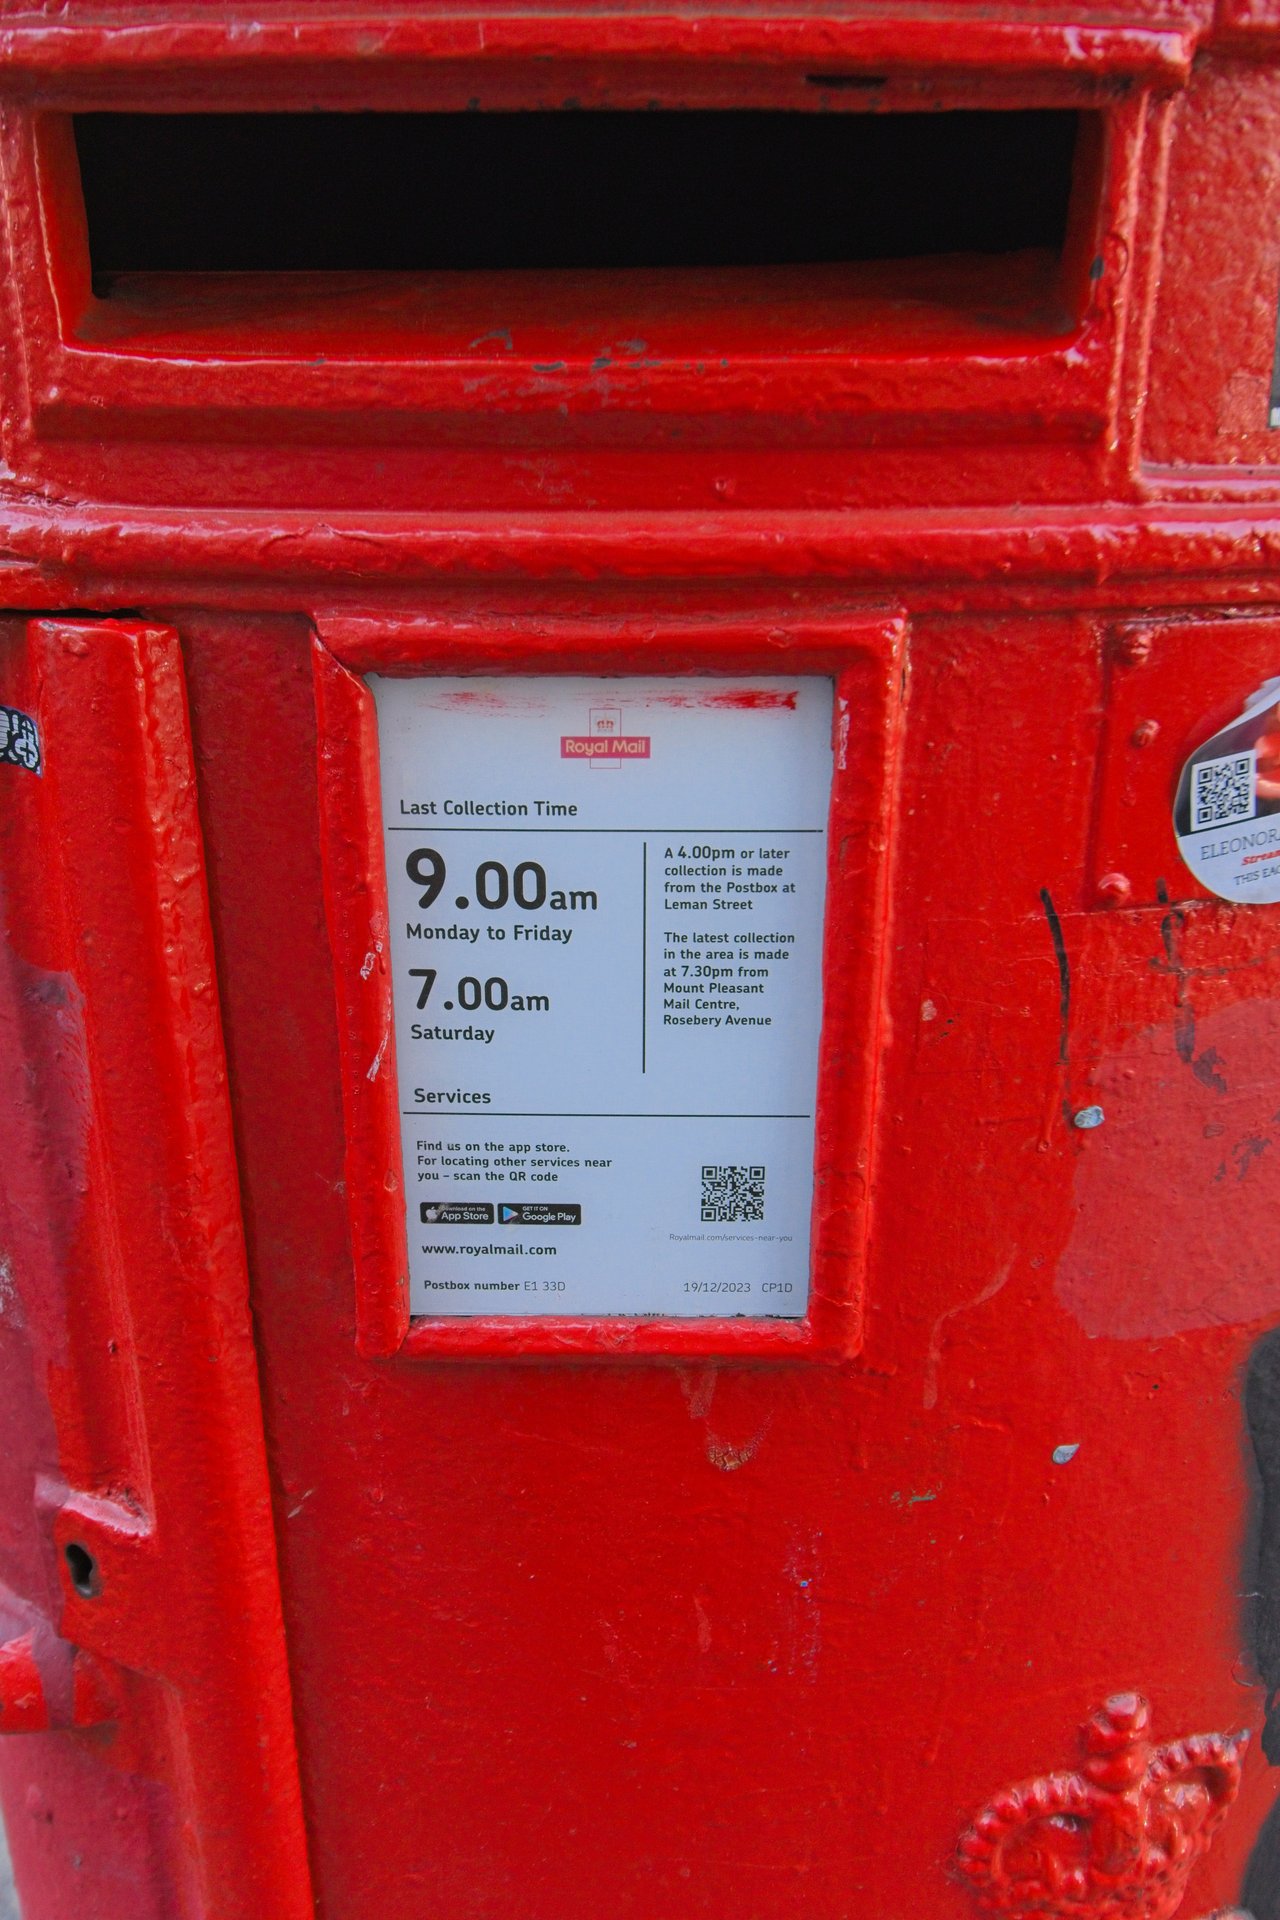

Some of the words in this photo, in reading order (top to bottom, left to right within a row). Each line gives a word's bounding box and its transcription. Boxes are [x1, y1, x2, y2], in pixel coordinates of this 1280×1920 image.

[565, 740, 608, 756] Royal
[612, 740, 646, 753] Mail
[400, 800, 438, 815] Last
[444, 800, 528, 816] Collection
[534, 801, 578, 817] Time
[1200, 828, 1280, 860] ELEONOR
[665, 848, 674, 859] A
[678, 846, 736, 862] 4.00pm
[741, 851, 755, 859] or
[760, 848, 791, 860] later
[665, 865, 727, 877] collection
[732, 865, 743, 877] is
[747, 865, 784, 877] made
[406, 848, 597, 910] 9.00am
[1234, 870, 1260, 886] THIS
[664, 882, 696, 893] from
[701, 882, 722, 894] the
[727, 882, 778, 894] Postbox
[783, 883, 796, 894] at
[665, 899, 708, 910] Leman
[713, 899, 753, 910] Street
[406, 923, 480, 944] Monday
[487, 926, 506, 941] to
[514, 925, 573, 945] Friday
[664, 932, 689, 944] The
[693, 932, 730, 944] latest
[734, 932, 796, 944] collection
[664, 948, 676, 960] in
[680, 949, 702, 960] the
[706, 952, 734, 960] area
[739, 949, 750, 960] is
[754, 949, 790, 960] made
[664, 968, 677, 978] at
[681, 966, 734, 980] 7.30pm
[738, 967, 769, 978] from
[408, 969, 549, 1011] 7.00am
[664, 983, 705, 994] Mount
[710, 983, 765, 994] Pleasant
[664, 999, 690, 1010] Mail
[695, 999, 740, 1011] Centre,
[664, 1015, 722, 1028] Rosebery
[725, 1015, 772, 1026] Avenue
[411, 1024, 495, 1045] Saturday
[414, 1088, 492, 1104] Services
[417, 1141, 443, 1151] Find
[447, 1144, 461, 1152] us
[465, 1144, 481, 1152] on
[485, 1142, 505, 1152] the
[509, 1144, 532, 1155] app
[536, 1143, 570, 1153] store.
[418, 1156, 438, 1166] For
[441, 1156, 490, 1169] locating
[494, 1157, 527, 1167] other
[531, 1157, 580, 1168] services
[585, 1160, 613, 1168] near
[418, 1173, 440, 1183] you
[454, 1173, 481, 1181] scan
[485, 1172, 505, 1182] the
[510, 1172, 527, 1182] QR
[531, 1172, 559, 1182] code
[441, 1211, 462, 1221] App
[463, 1212, 489, 1221] Store
[522, 1213, 556, 1223] Google
[558, 1214, 576, 1223] Play
[422, 1244, 557, 1257] www.royalmail.com
[424, 1280, 471, 1290] Postbox
[474, 1282, 521, 1291] number
[525, 1281, 538, 1292] E1
[543, 1281, 566, 1292] 33D
[684, 1282, 752, 1294] 19/12/2023
[762, 1283, 793, 1294] CP1D
